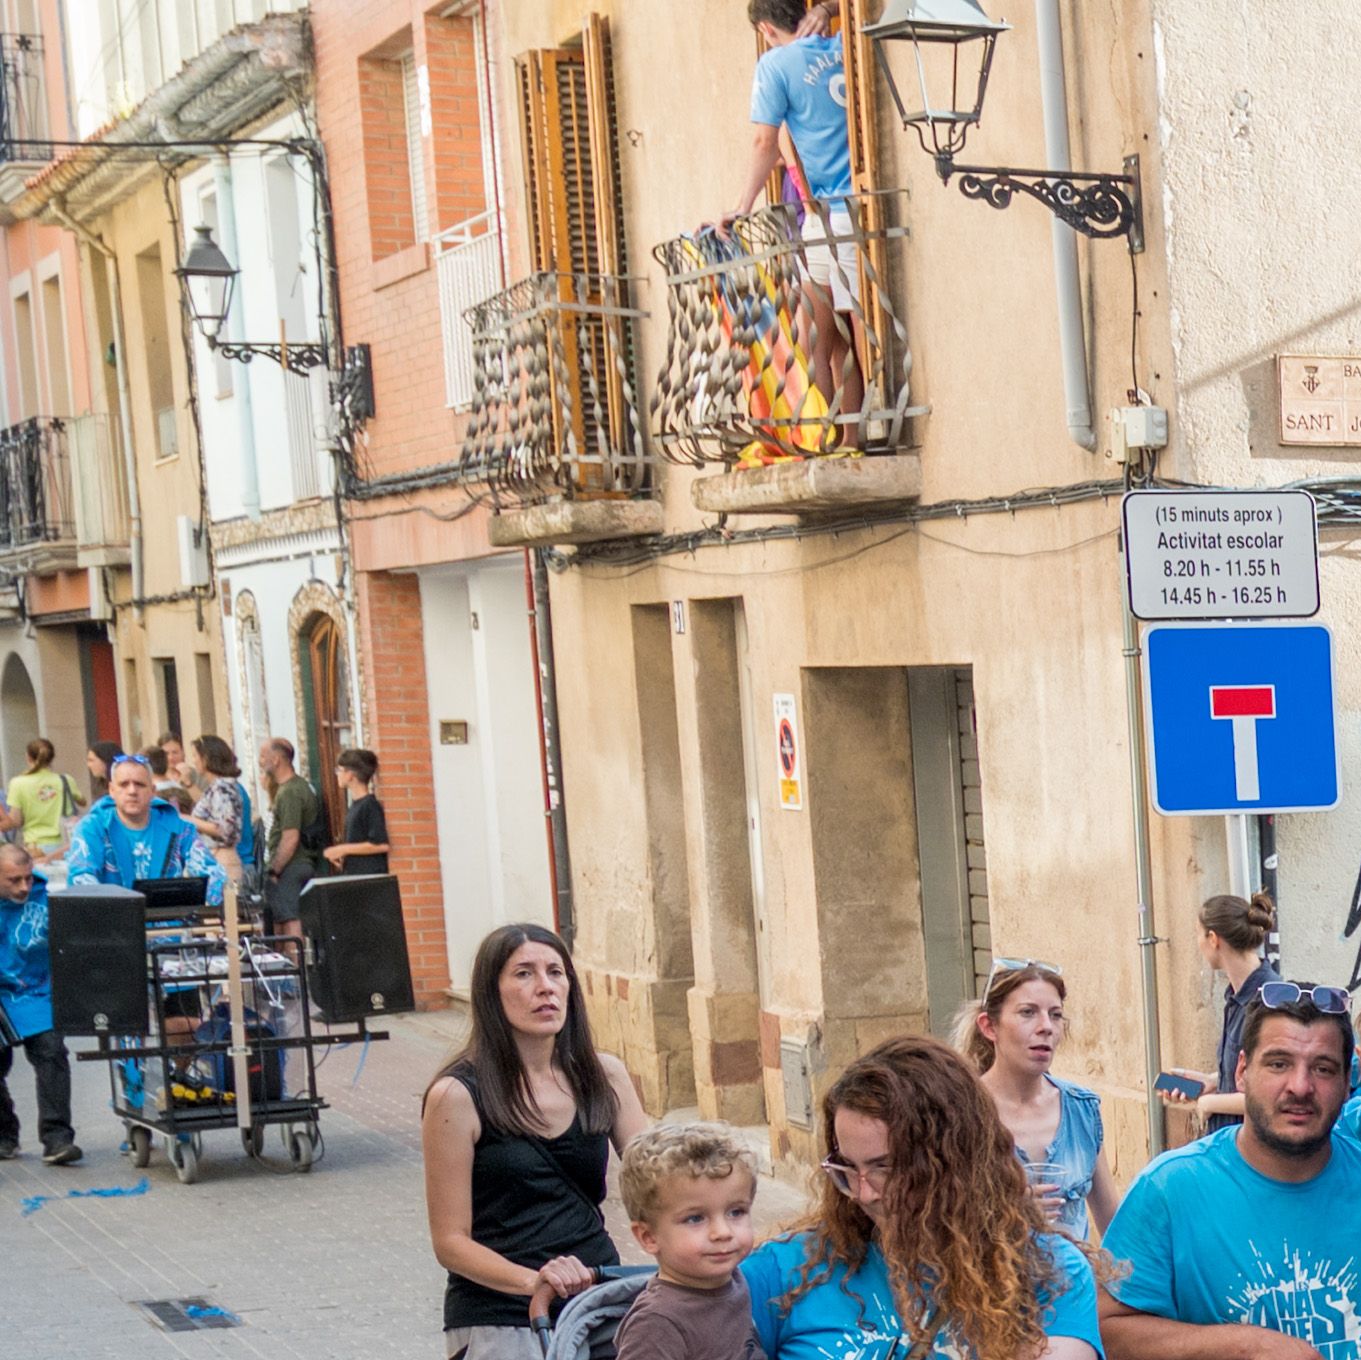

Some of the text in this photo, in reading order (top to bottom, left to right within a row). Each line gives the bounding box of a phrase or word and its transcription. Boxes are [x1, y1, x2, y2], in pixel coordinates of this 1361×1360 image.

[1285, 413, 1334, 431] SANT
[1155, 506, 1178, 526] (15
[1181, 506, 1230, 523] minuts
[1157, 531, 1285, 550] Activitat escolar
[1163, 560, 1196, 577] 8.20
[1200, 560, 1211, 577] h
[1225, 559, 1267, 577] 11.55
[1271, 558, 1281, 576] h
[1160, 587, 1201, 605] 14.45
[1206, 587, 1217, 604] h
[1232, 586, 1273, 604] 16.25
[1277, 586, 1287, 603] h
